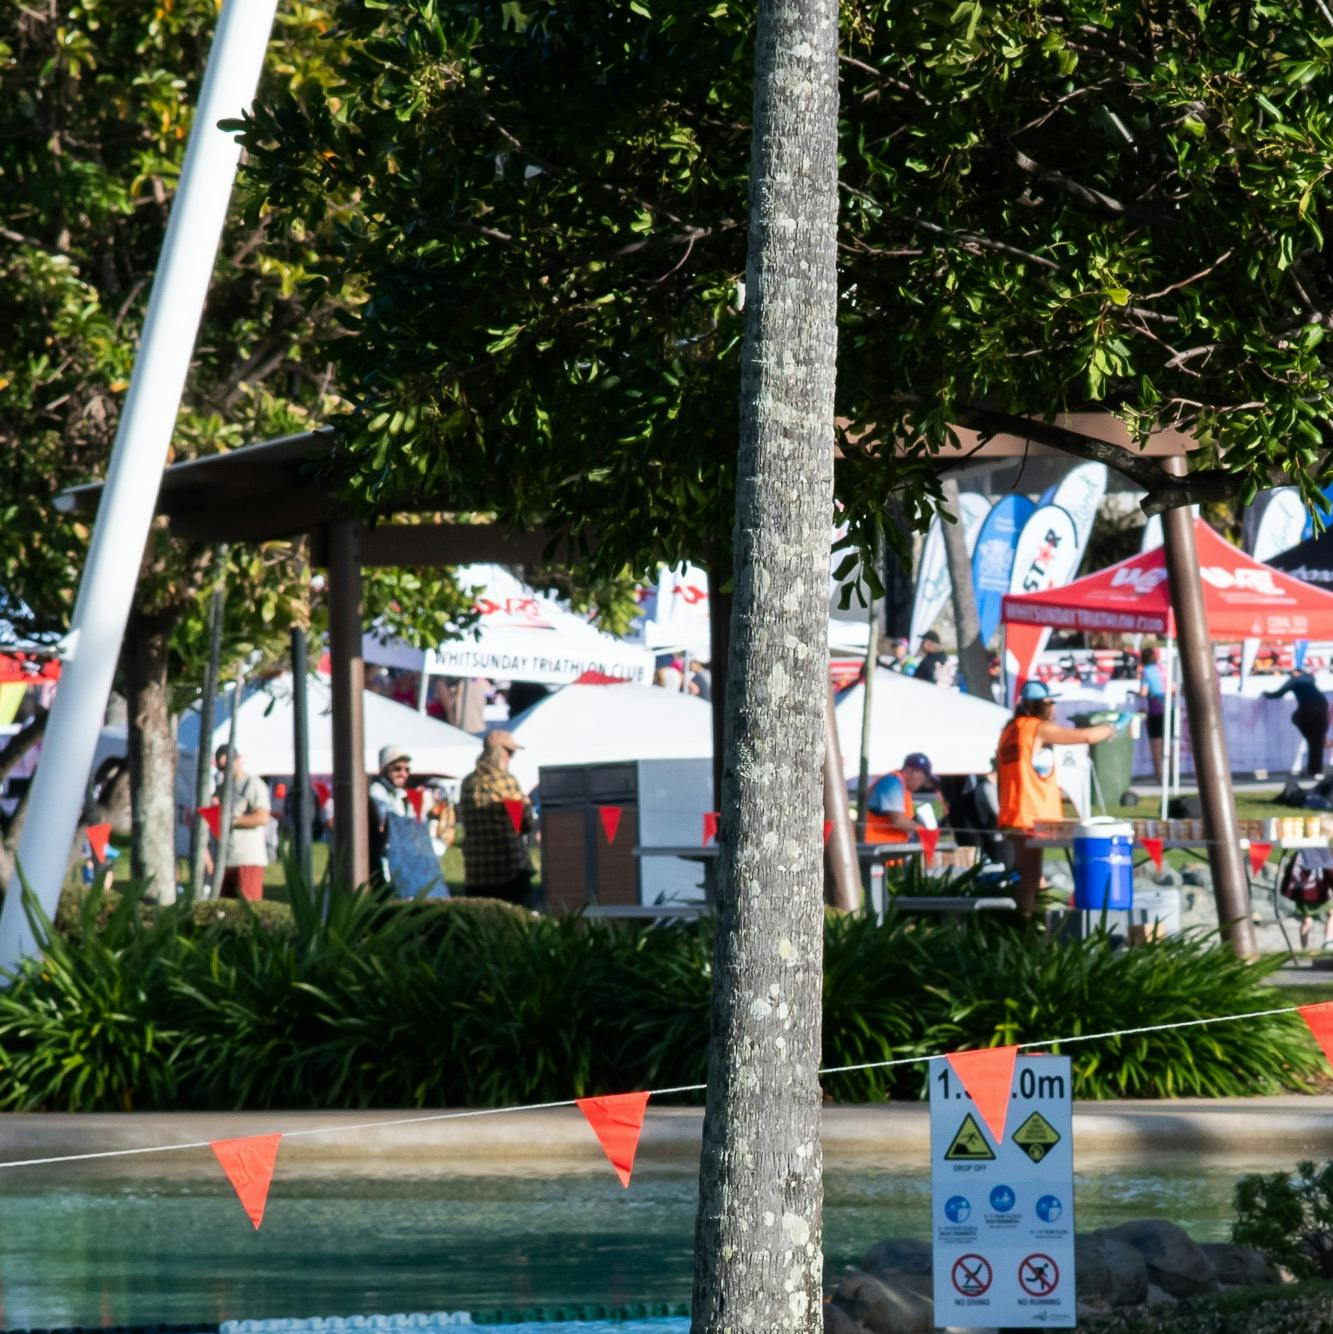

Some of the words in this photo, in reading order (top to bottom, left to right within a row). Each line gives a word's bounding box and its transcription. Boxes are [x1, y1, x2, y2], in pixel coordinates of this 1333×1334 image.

[435, 651, 528, 670] WHITSUNDAY
[533, 657, 606, 676] TRIATHLON
[611, 664, 644, 681] CLUB
[954, 1298, 965, 1306] NO
[1017, 1298, 1029, 1306] NO
